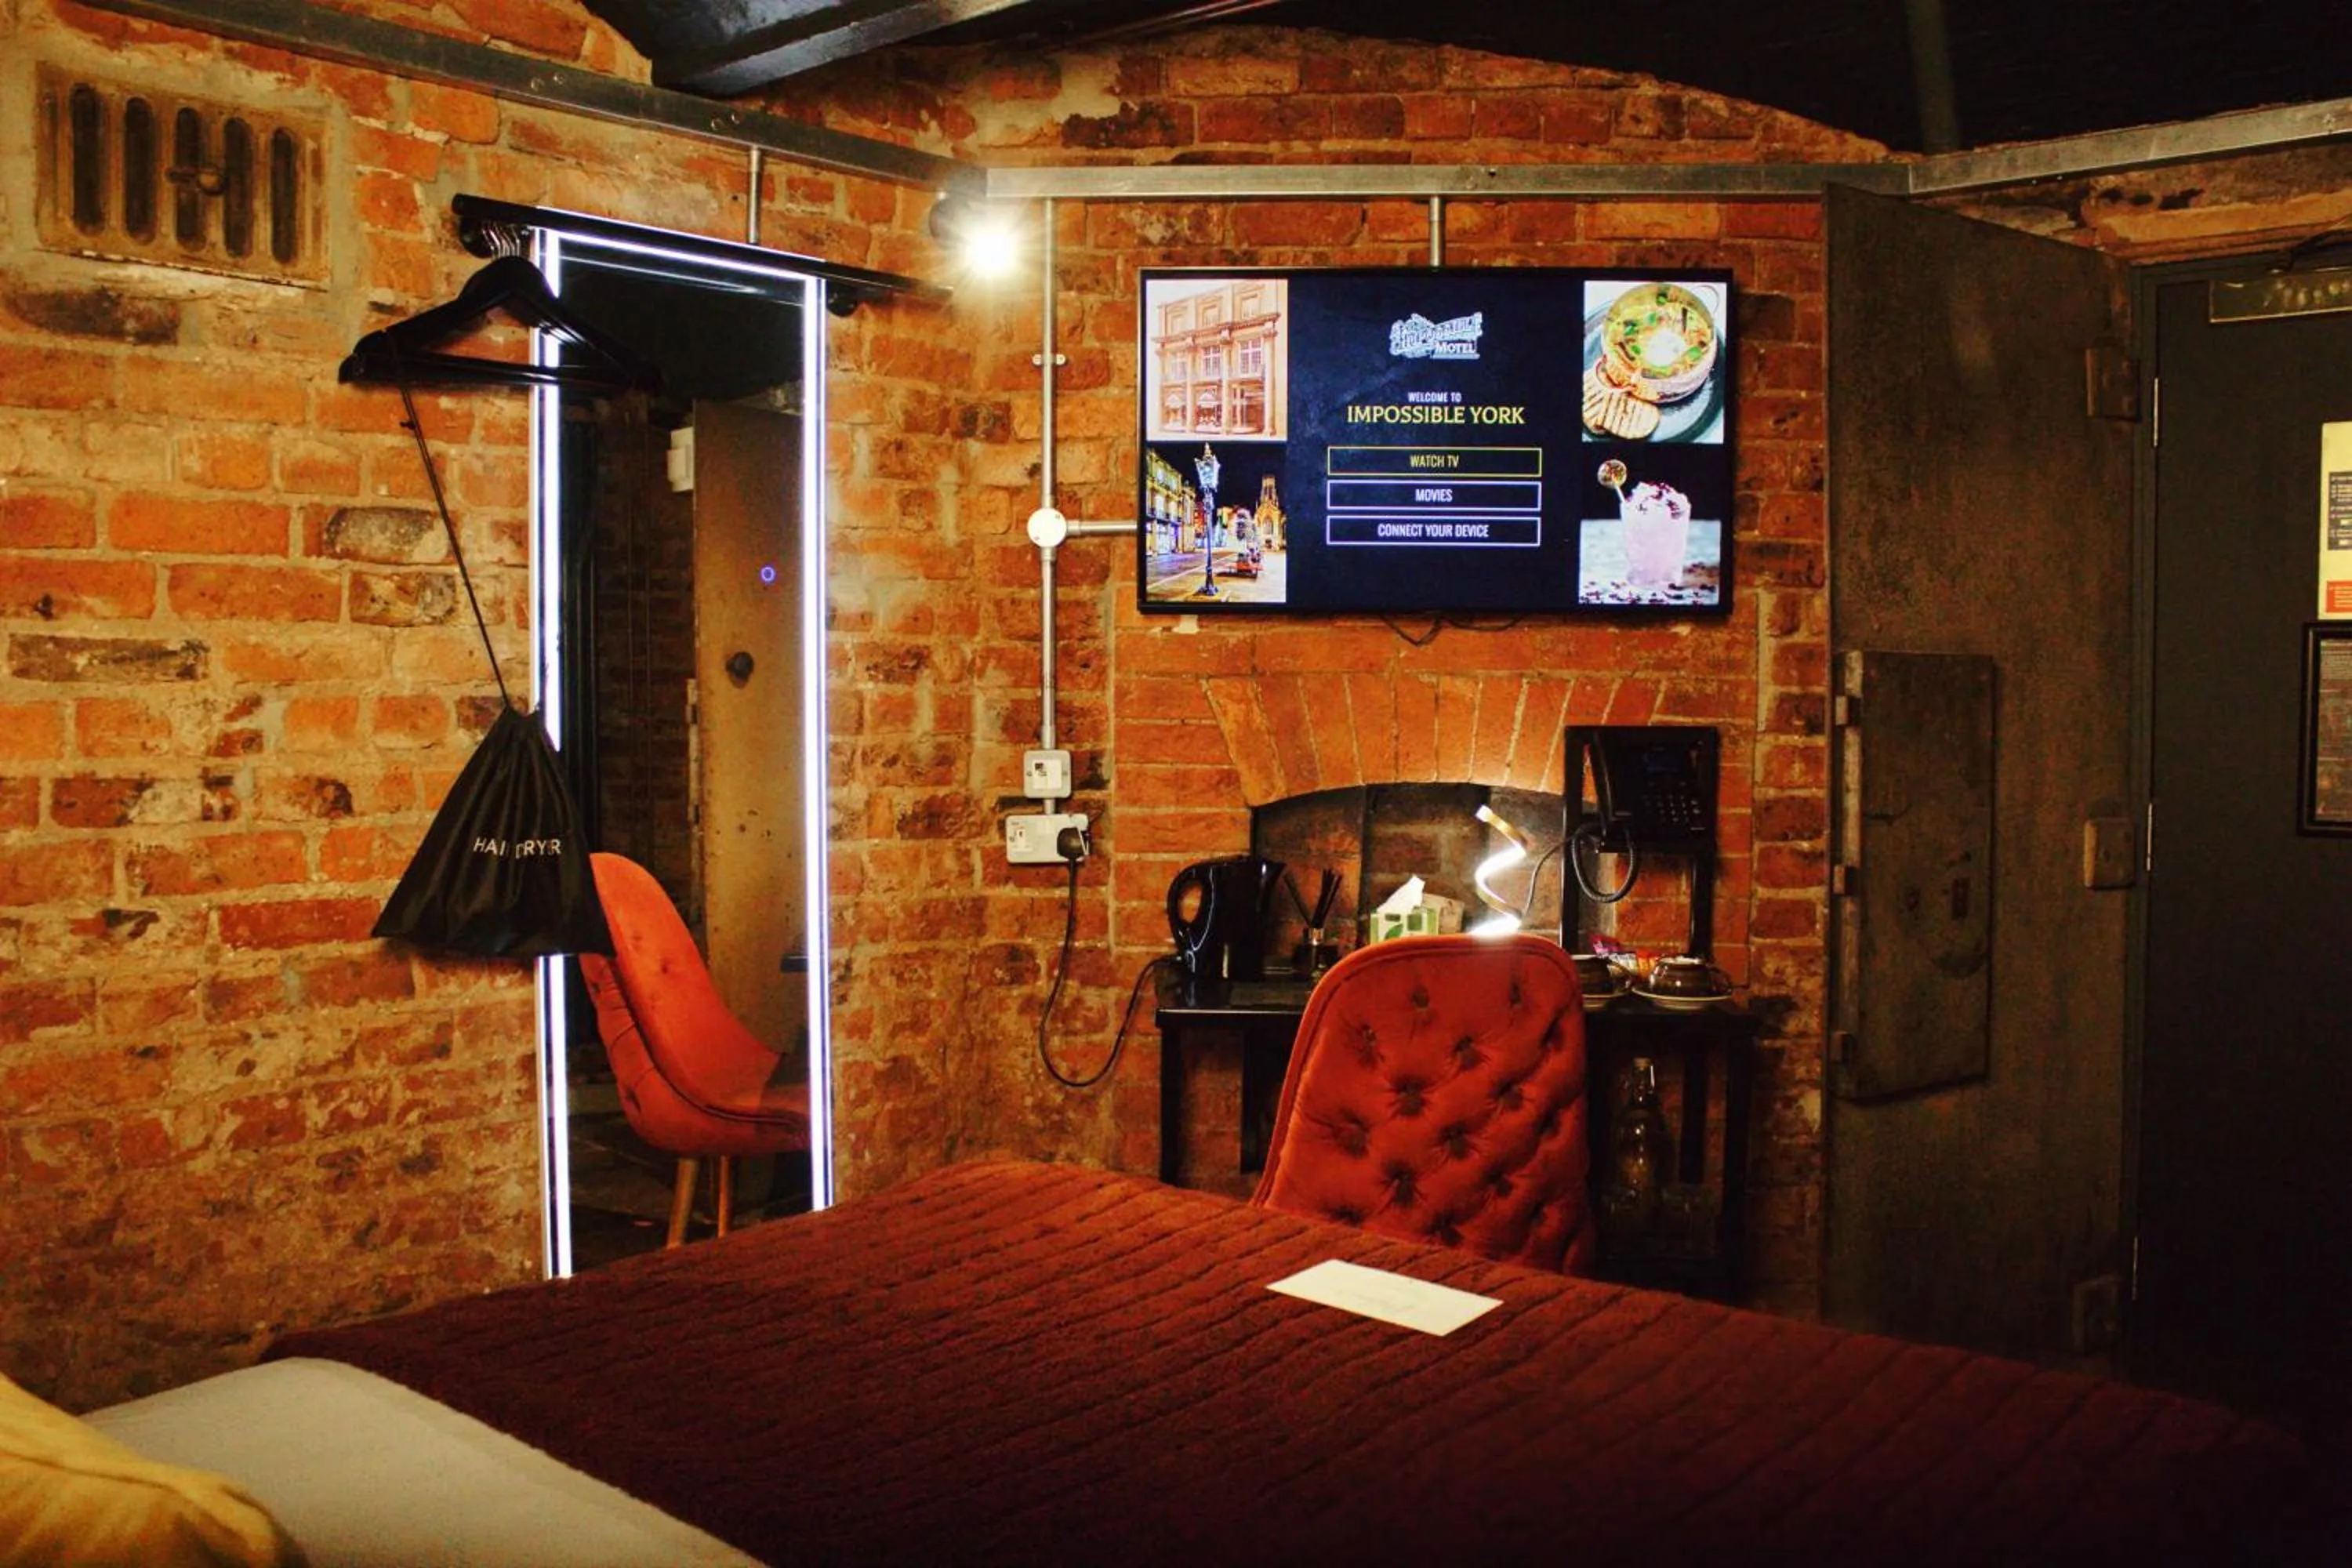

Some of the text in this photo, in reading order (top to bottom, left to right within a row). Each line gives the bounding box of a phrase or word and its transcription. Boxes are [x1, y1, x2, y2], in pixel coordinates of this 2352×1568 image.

[1436, 342, 1476, 354] MOTEL
[1408, 392, 1462, 403] WELCOME TO
[1347, 405, 1525, 424] IMPOSSIBLE YORK
[1410, 455, 1459, 468] WATCH TV
[1415, 488, 1453, 502] MOVIES
[1377, 523, 1490, 538] CONNECT YOUR DEVICE
